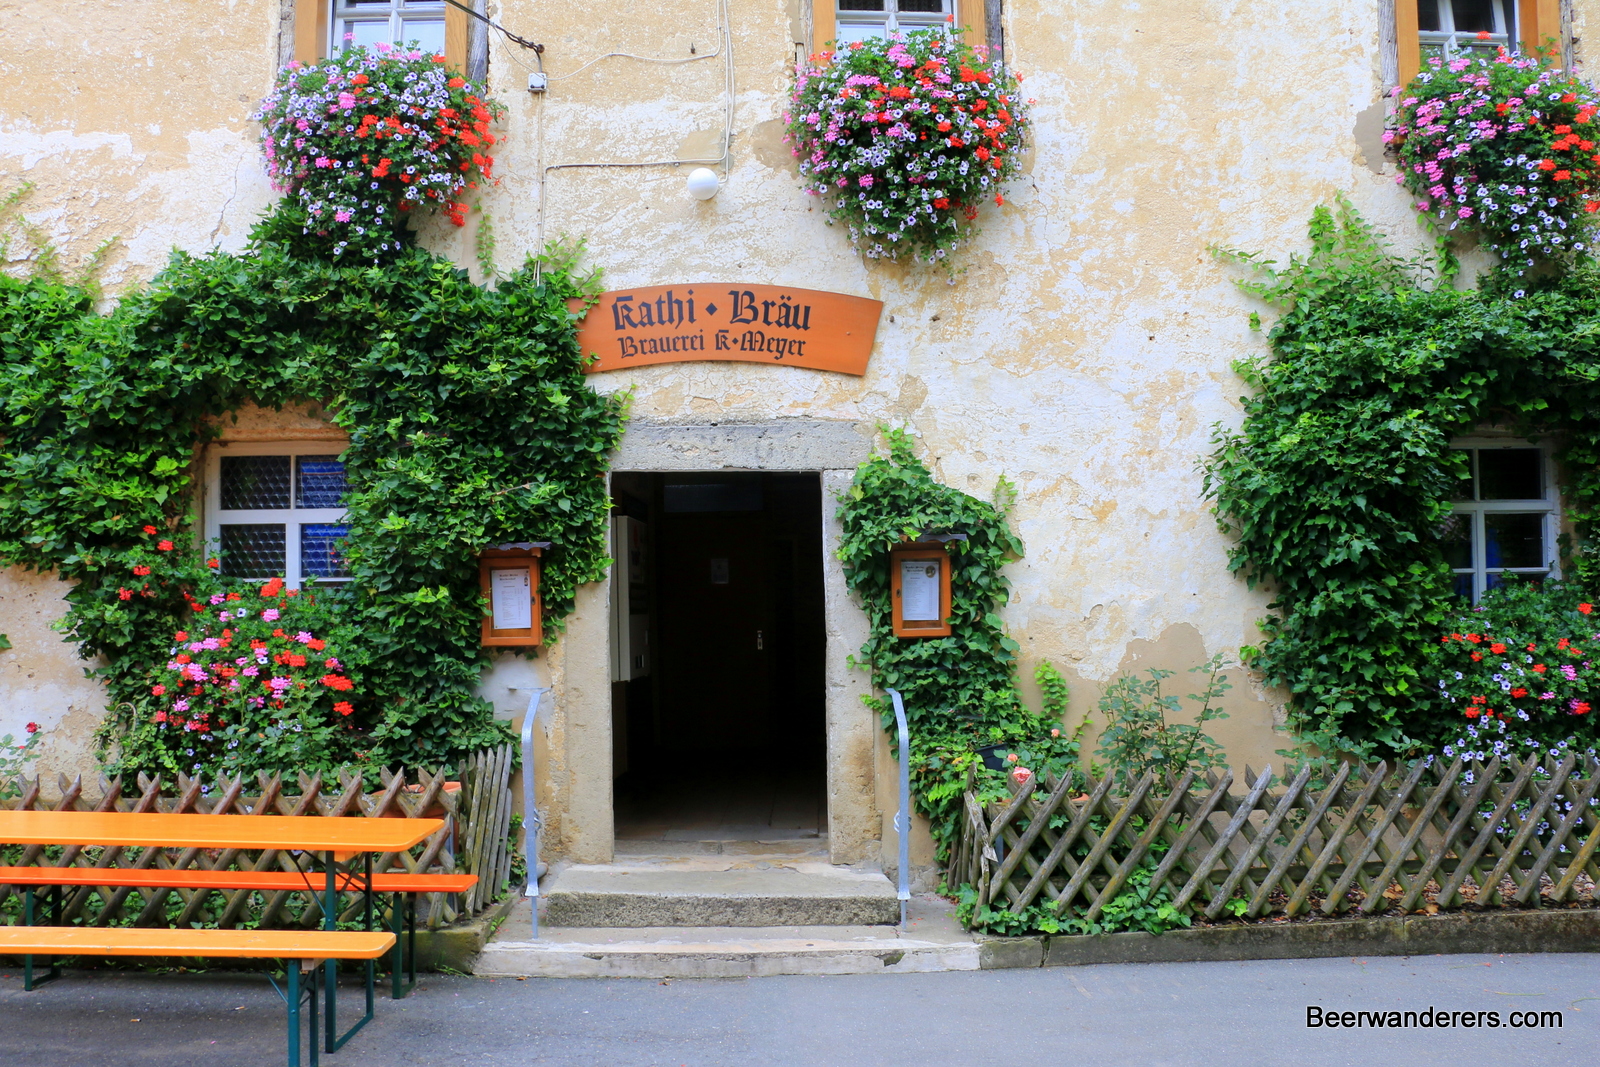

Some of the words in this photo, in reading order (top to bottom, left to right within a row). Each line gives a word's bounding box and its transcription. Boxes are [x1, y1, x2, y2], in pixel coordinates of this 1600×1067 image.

[611, 289, 697, 330] Kathi
[727, 289, 811, 331] Bräu
[617, 329, 705, 359] Brauerei
